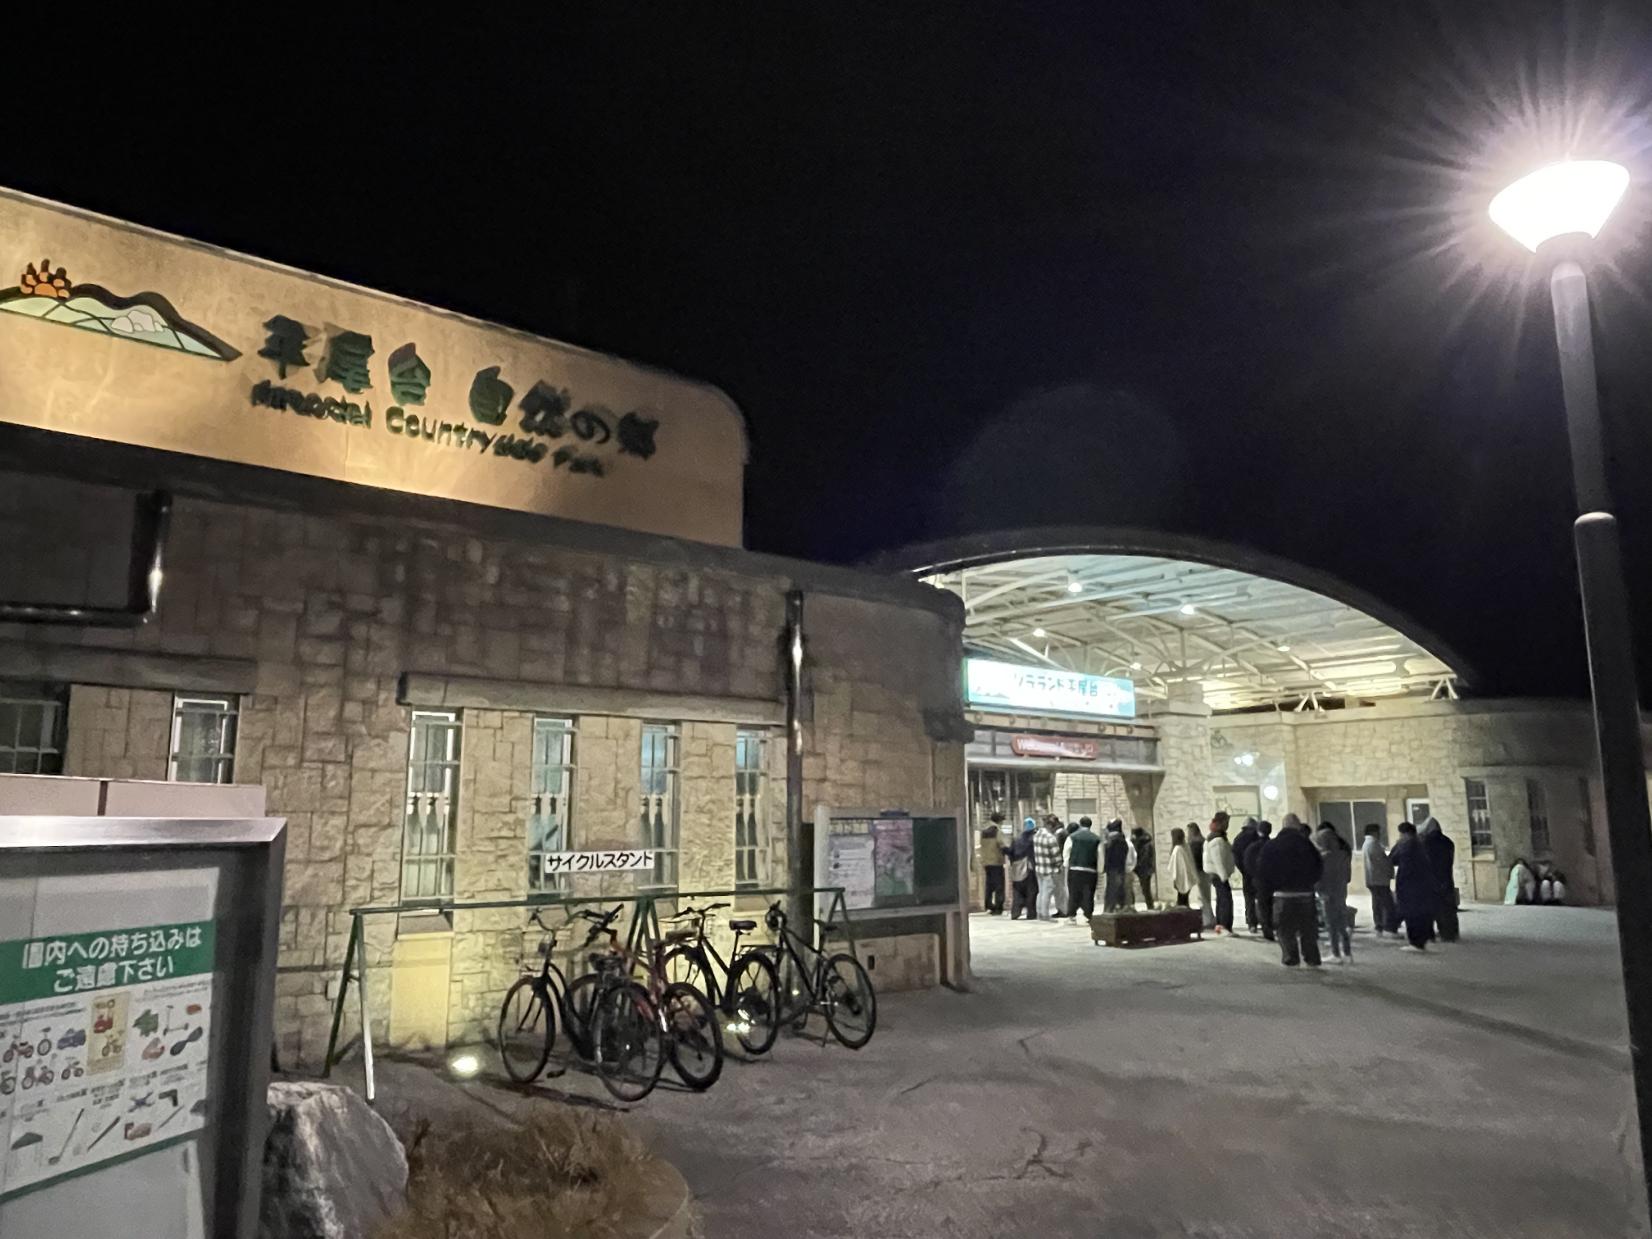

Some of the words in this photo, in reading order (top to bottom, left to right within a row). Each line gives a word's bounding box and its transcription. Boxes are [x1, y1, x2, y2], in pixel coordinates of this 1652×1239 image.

[23, 926, 202, 969] 園内への持ち込みは
[53, 956, 174, 992] ご遠慮下さい
